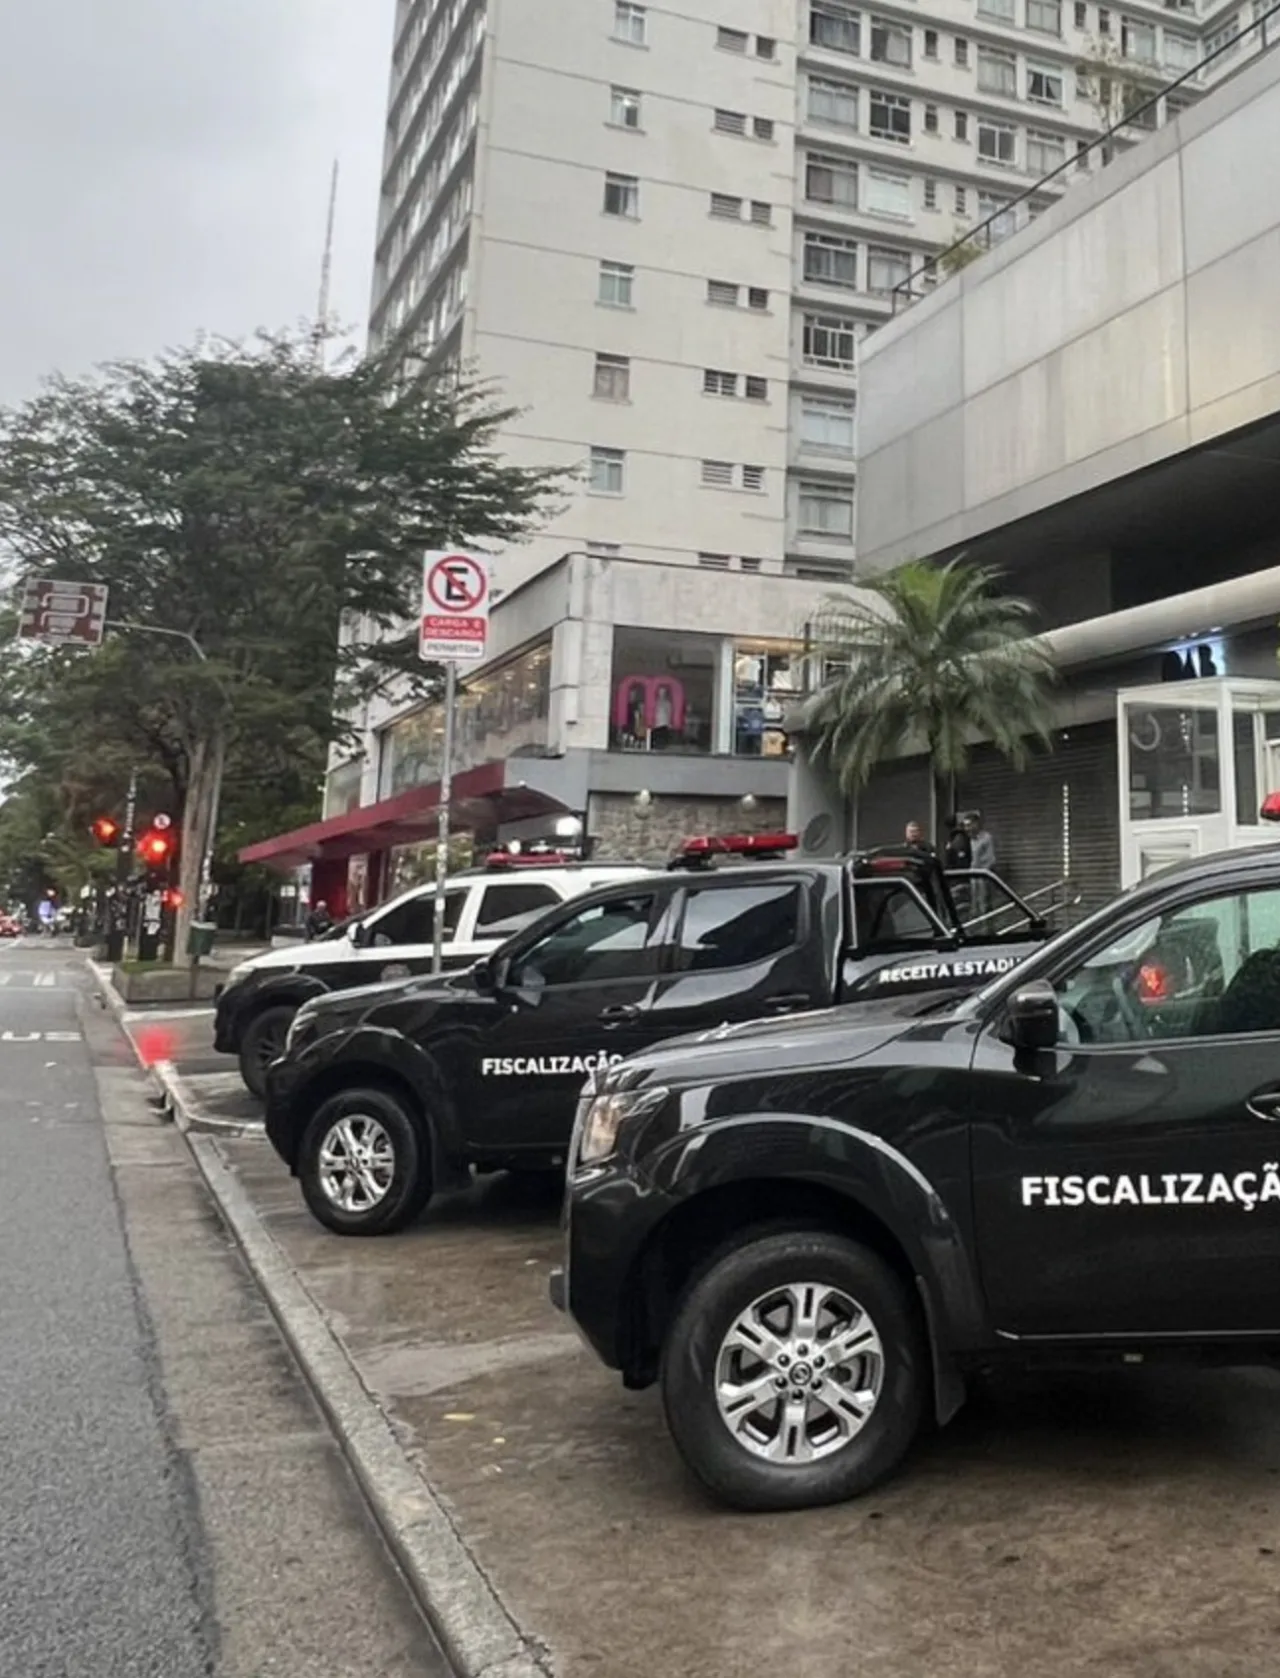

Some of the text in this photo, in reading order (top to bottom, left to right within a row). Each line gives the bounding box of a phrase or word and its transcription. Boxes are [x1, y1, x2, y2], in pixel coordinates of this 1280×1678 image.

[446, 567, 468, 600] E
[429, 617, 468, 628] CARGA
[425, 627, 483, 638] DESCARGA
[879, 957, 1022, 984] RECEITA ESTAD
